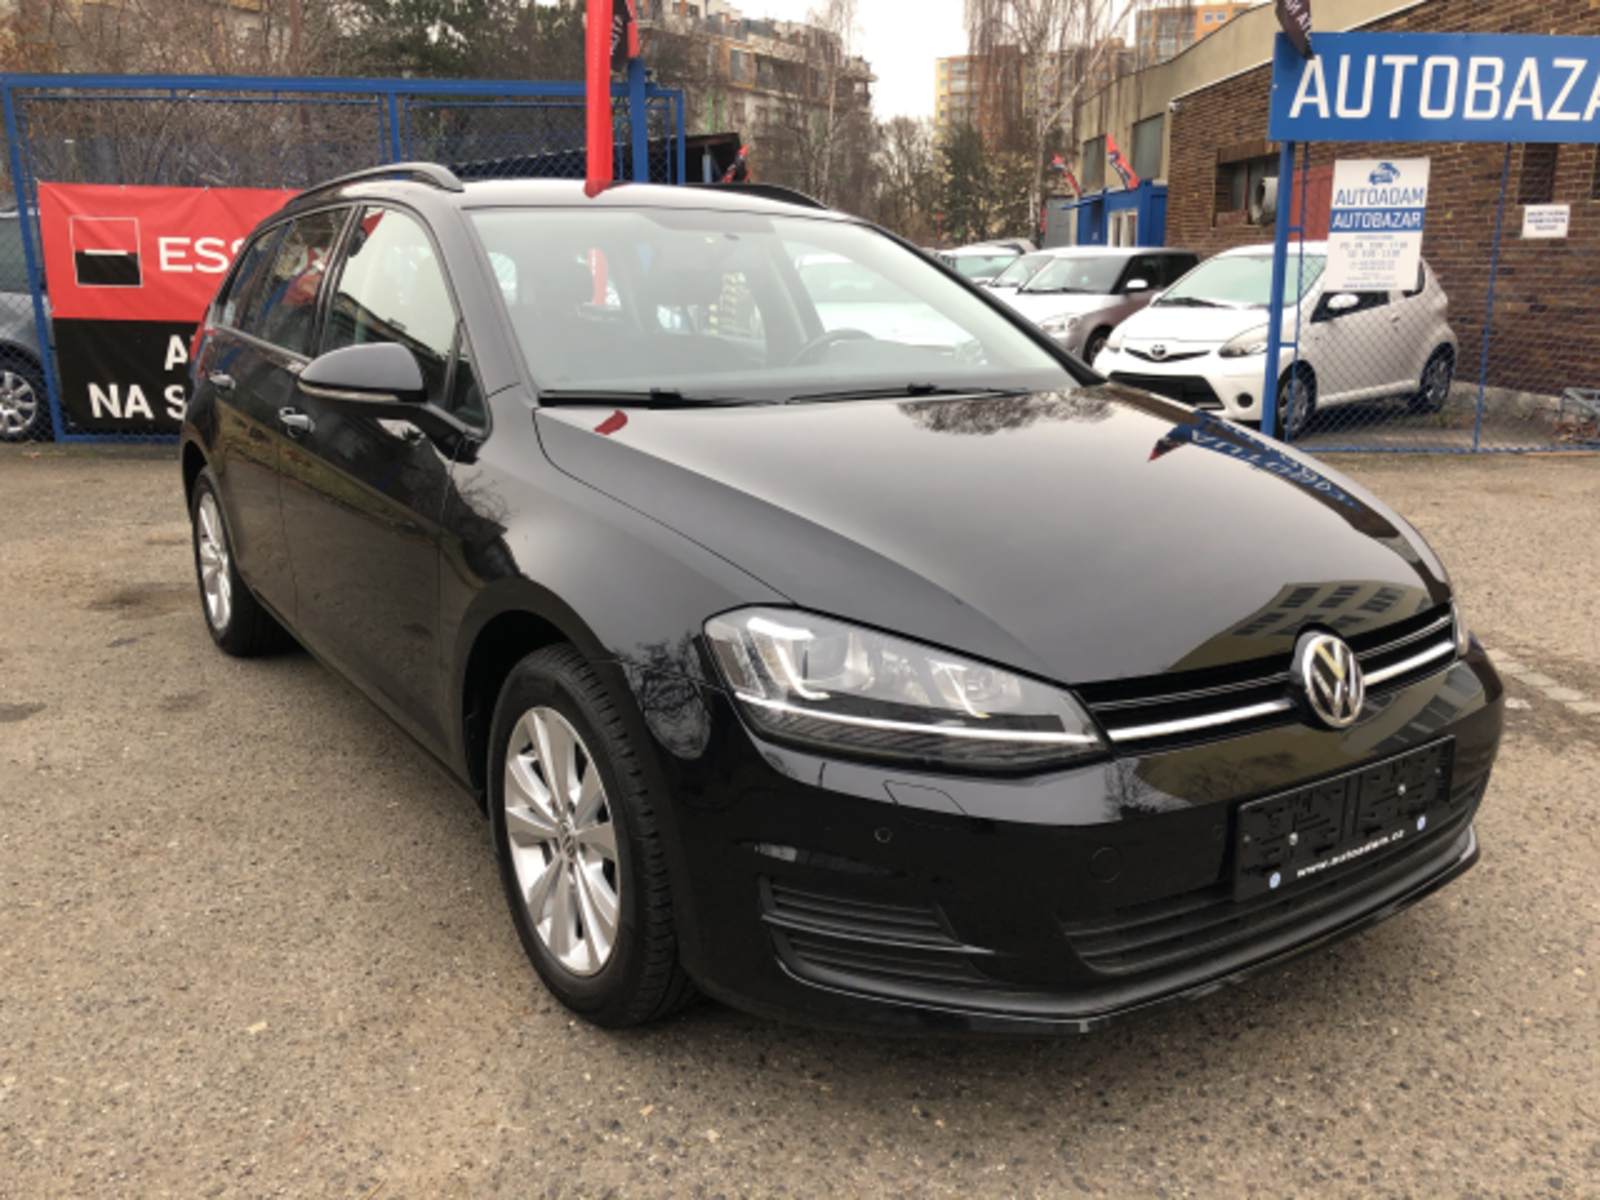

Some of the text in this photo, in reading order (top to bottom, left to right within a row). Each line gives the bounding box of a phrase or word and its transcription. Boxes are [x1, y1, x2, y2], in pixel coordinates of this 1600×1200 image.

[1334, 187, 1425, 206] AUTOADAM
[1332, 211, 1422, 229] AUTOBAZAR
[87, 382, 155, 419] NA
